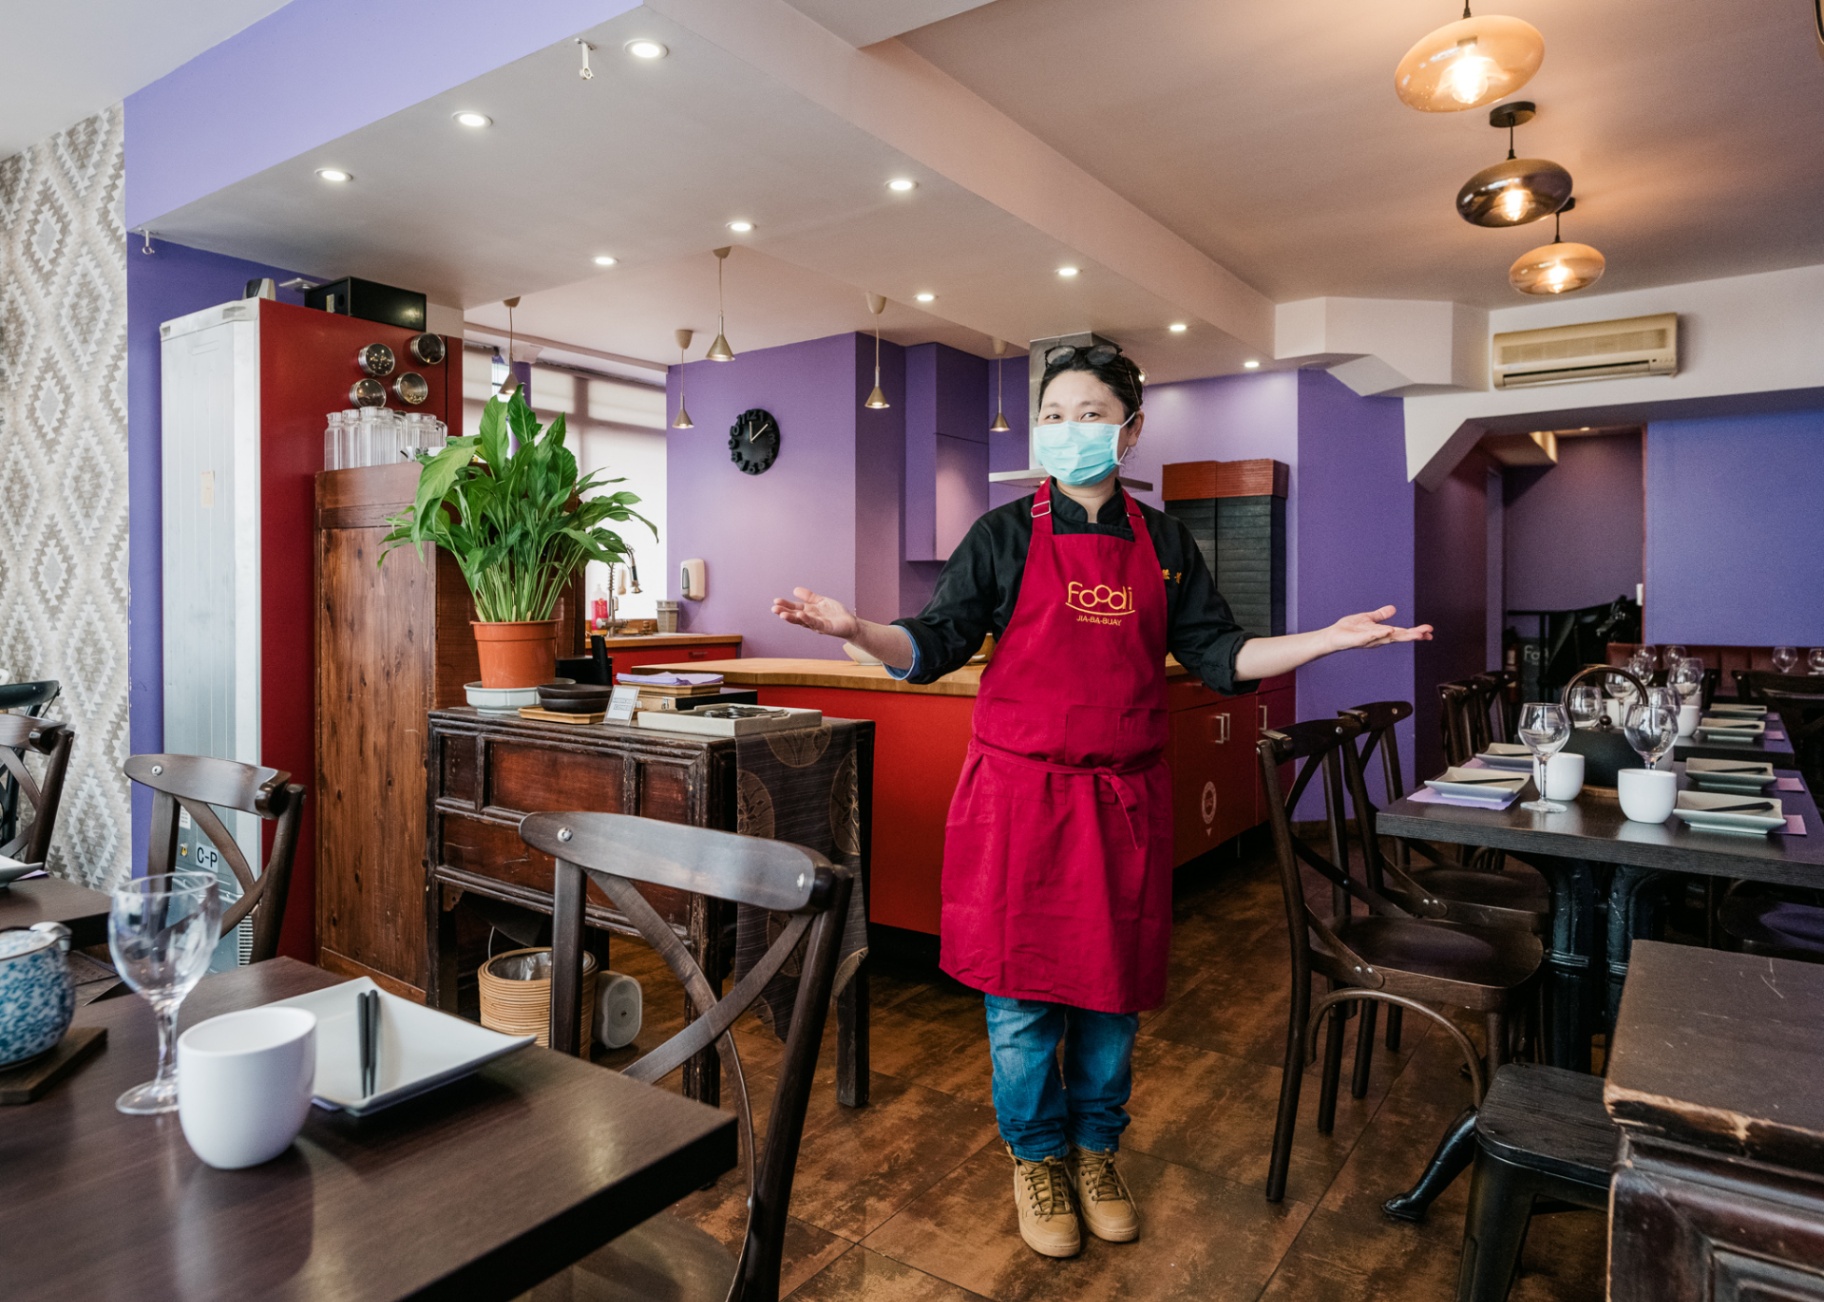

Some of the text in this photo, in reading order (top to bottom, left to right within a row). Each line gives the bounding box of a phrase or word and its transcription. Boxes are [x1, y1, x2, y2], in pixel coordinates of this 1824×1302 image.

[1067, 580, 1132, 611] Foodi
[1076, 614, 1122, 627] JIA-BA-BUAY
[196, 846, 219, 869] C-P
